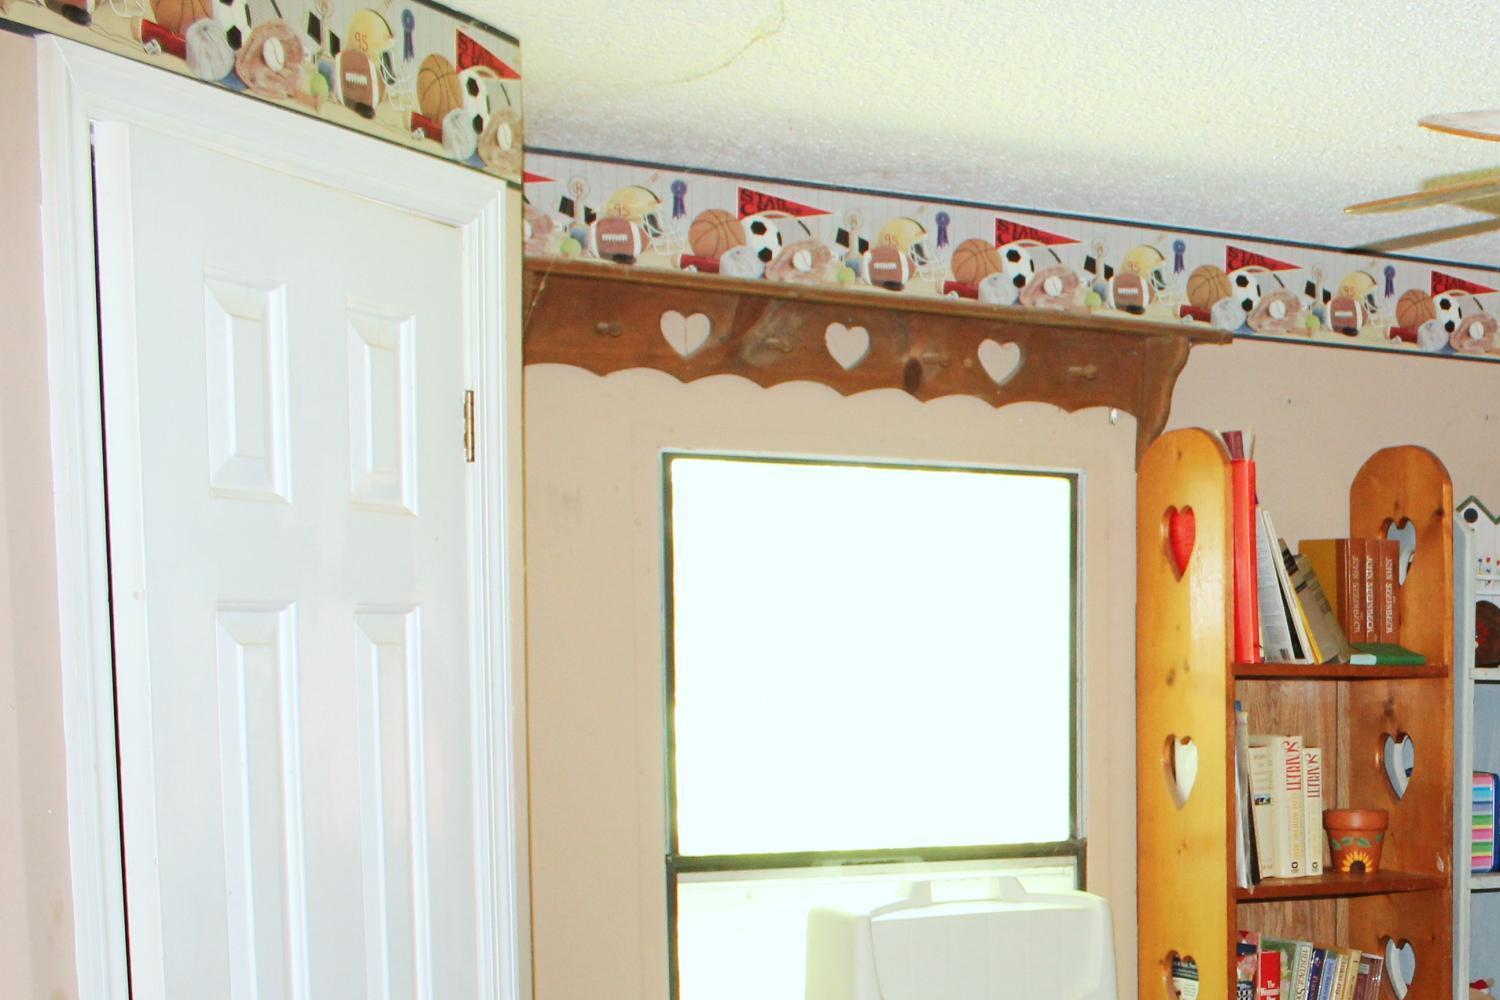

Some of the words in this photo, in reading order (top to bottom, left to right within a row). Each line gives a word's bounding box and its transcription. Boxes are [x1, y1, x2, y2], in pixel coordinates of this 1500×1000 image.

[1282, 741, 1301, 792] SCARLETT
[1305, 753, 1320, 798] SCARLETT
[1297, 949, 1308, 988] HERITAGE
